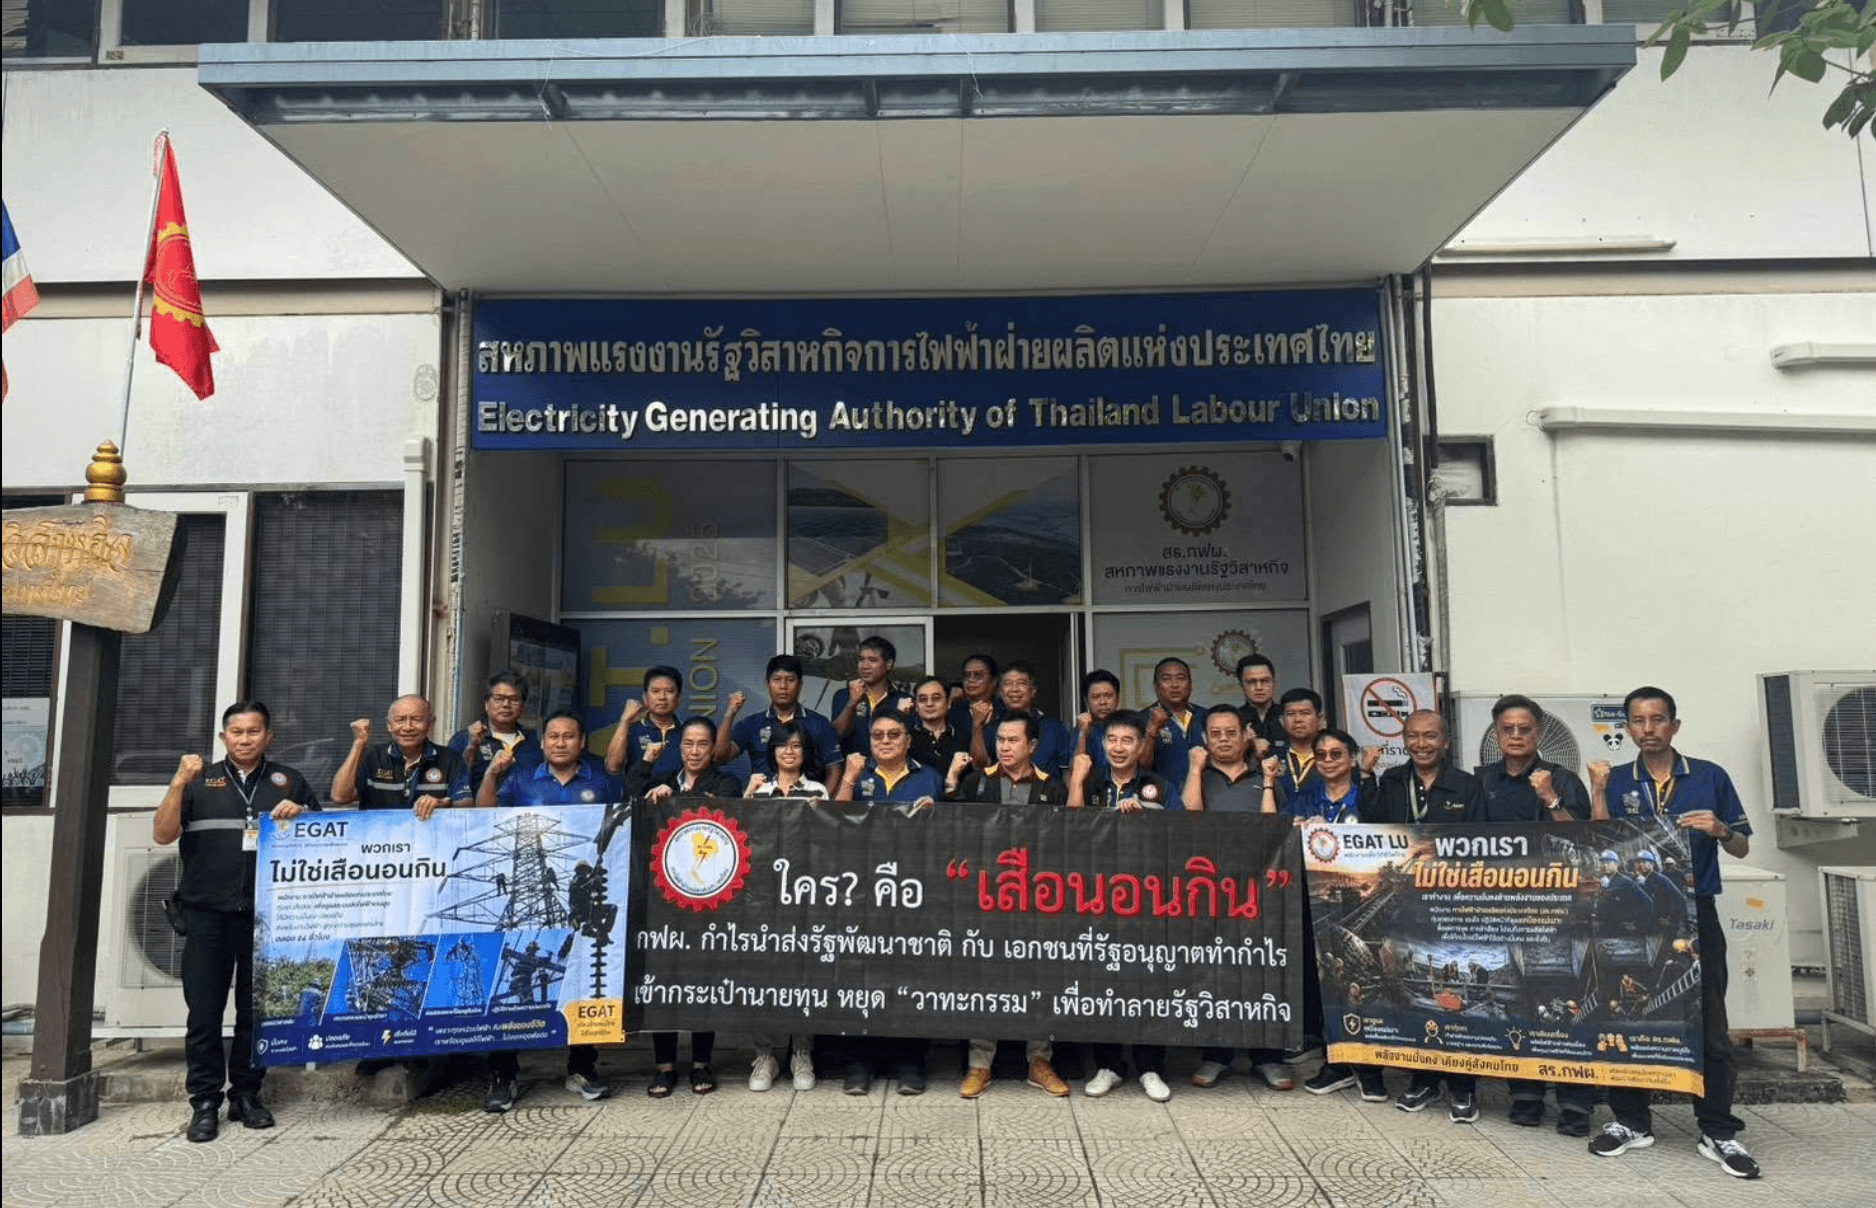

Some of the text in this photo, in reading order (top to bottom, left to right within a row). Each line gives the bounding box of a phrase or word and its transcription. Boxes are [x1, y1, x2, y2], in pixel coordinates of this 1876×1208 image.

[478, 321, 1375, 382] สหภาพแรงงานรัฐวิสาหกิจการไฟฟ้าฝ่ายผลิตแห่งประเทศไทย
[478, 391, 1381, 439] Electricity Generating Authority of Thailand Labour Union
[1105, 559, 1289, 578] สหภาพแรงงานรัฐวิสาหกิจ
[294, 821, 349, 838] EGAT
[361, 842, 411, 854] พวกเรา
[1343, 834, 1409, 850] EGAT LU
[1435, 835, 1528, 858] พวกเรา
[270, 857, 446, 883] ไม่ใช่เสือนอนกิน
[1413, 860, 1579, 889] ไม่ใช่เสือนอนกิน
[773, 846, 1293, 919] ใคร? คือ “เสือนอนกิน”
[1729, 918, 1775, 931] Tasaki
[637, 922, 1287, 972] กฟผ. กำไรนำส่งรัฐพัฒนาชาติ กับ เอกชนที่รัฐอนุญาตทำกำไร
[578, 1005, 615, 1018] EGAT
[634, 975, 1292, 1028] เข้ากระเป๋านายทุน หยุด “วาทะกรรม” เพื่อทำลายรัฐวิสาหกิจ
[1375, 1050, 1519, 1073] พลังงานมั่นคง เคียงคู่สังคมไทย
[1539, 1064, 1599, 1080] สร.กฟผ.
